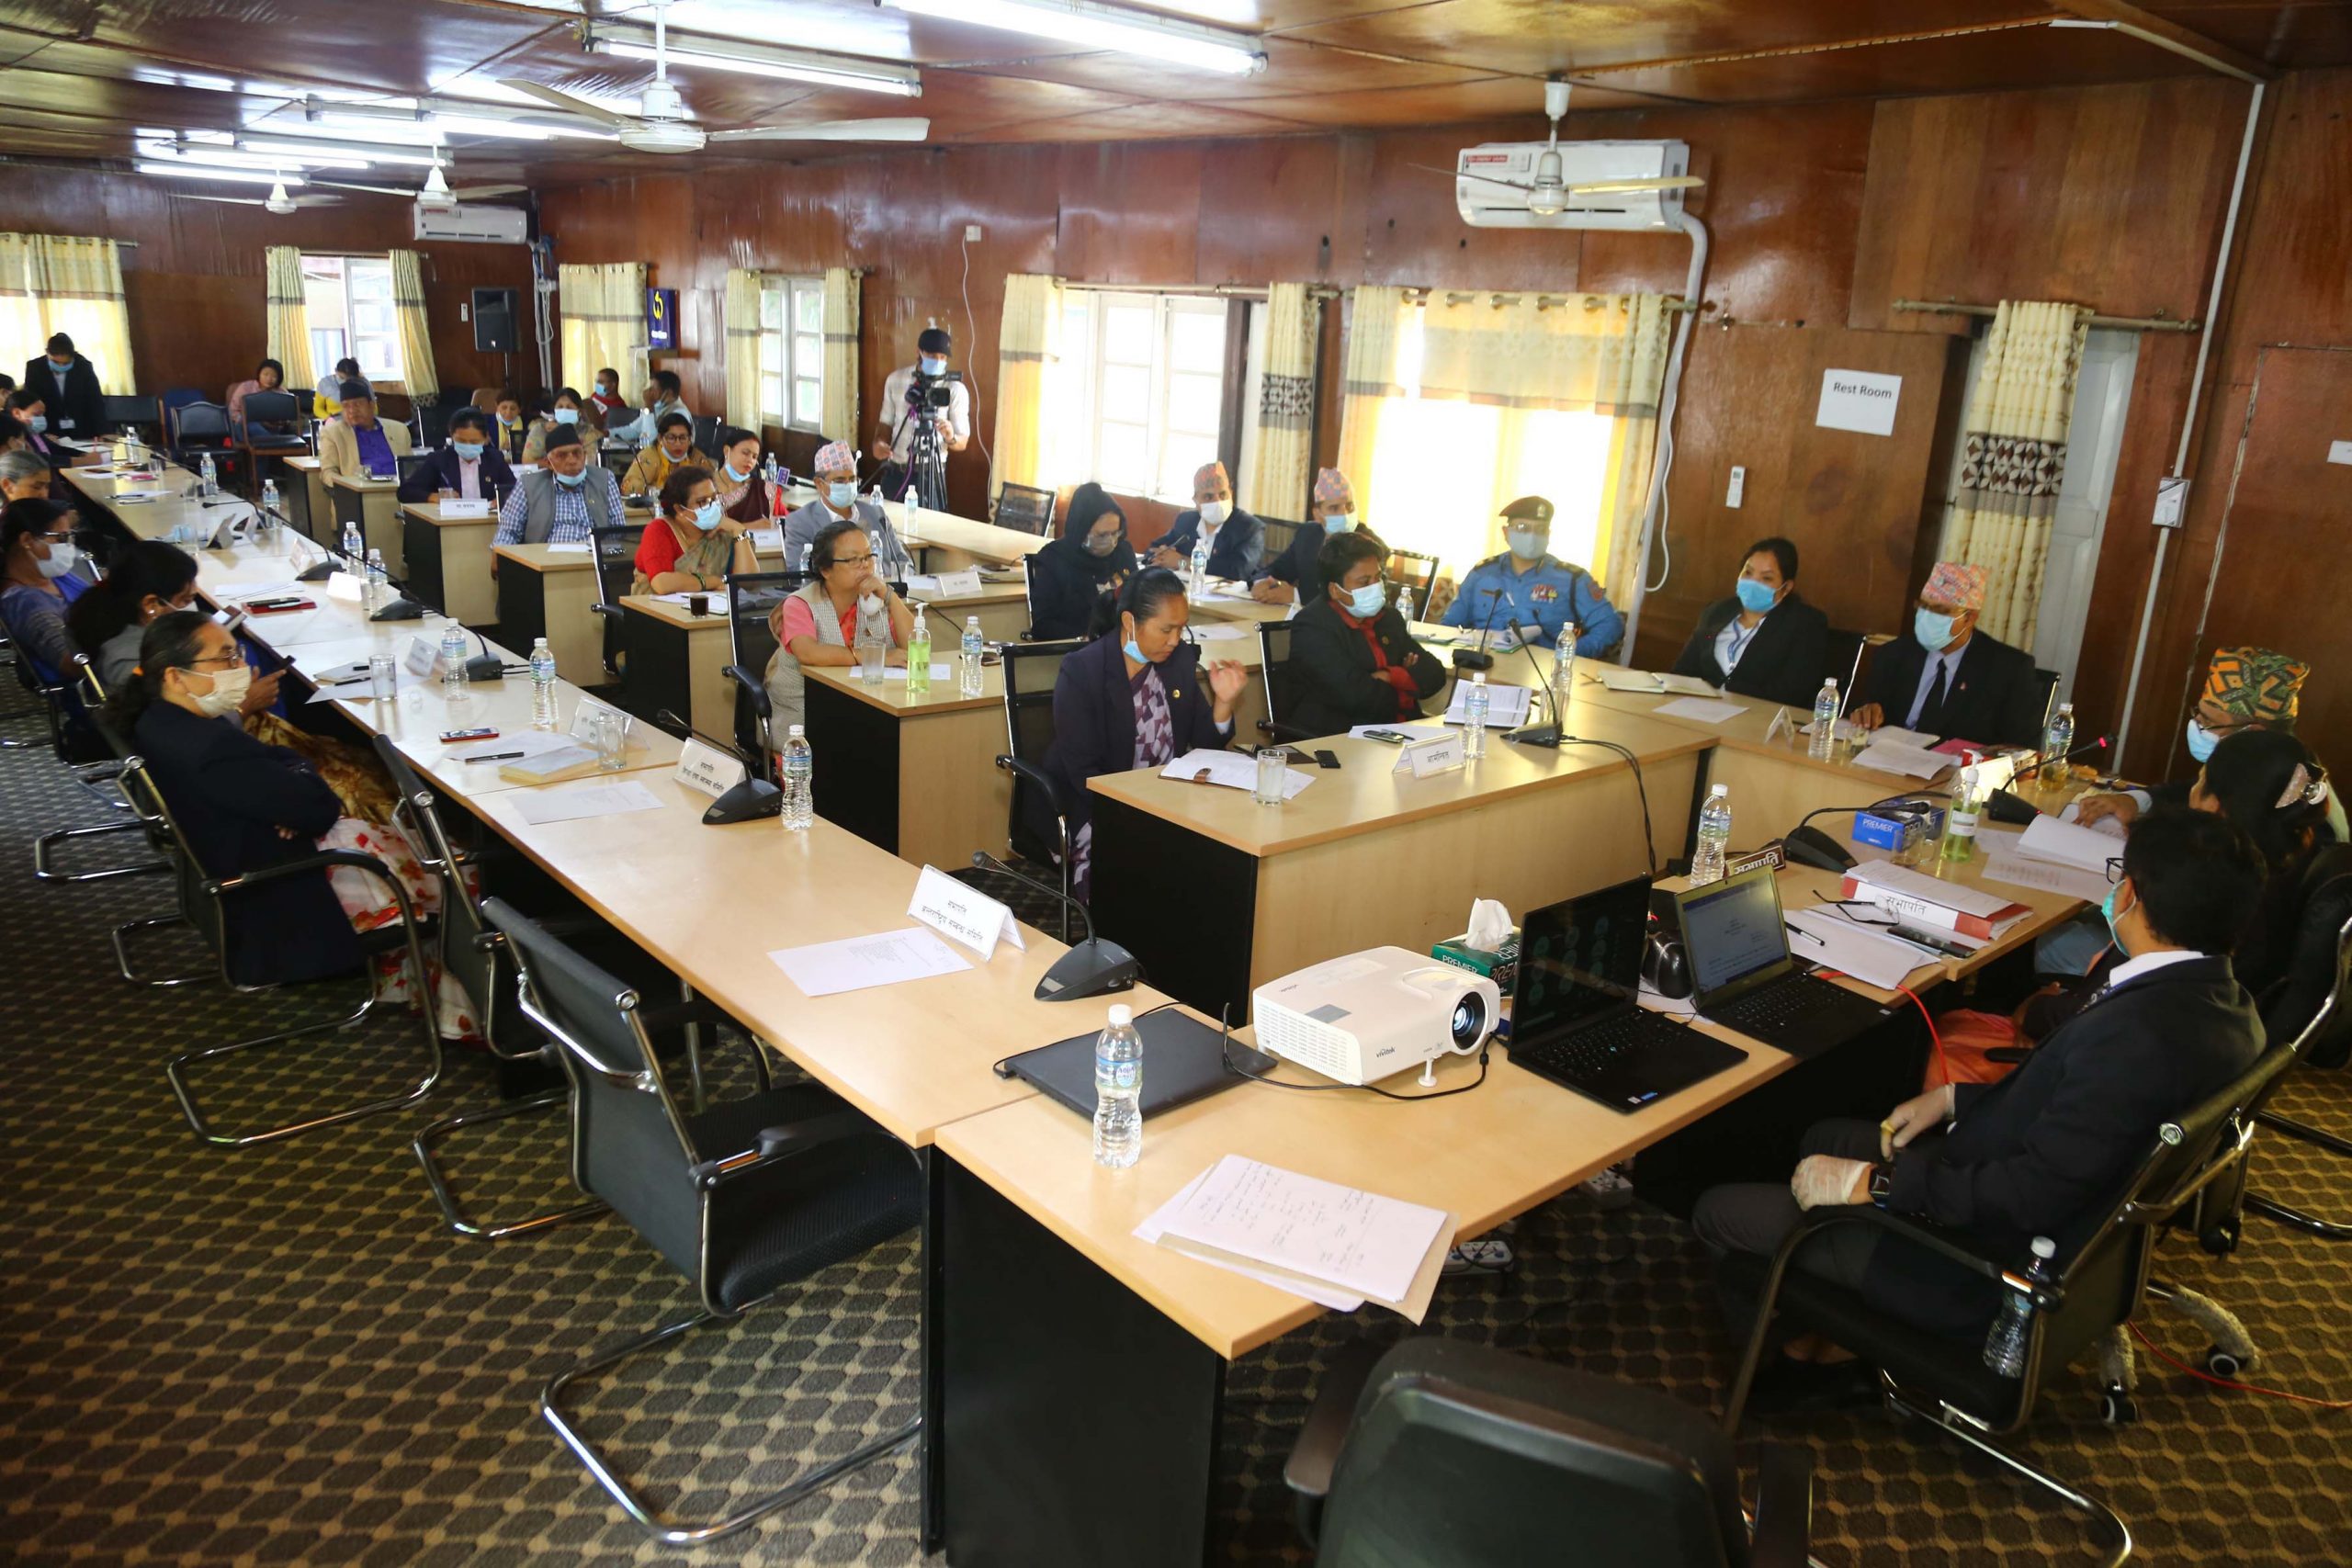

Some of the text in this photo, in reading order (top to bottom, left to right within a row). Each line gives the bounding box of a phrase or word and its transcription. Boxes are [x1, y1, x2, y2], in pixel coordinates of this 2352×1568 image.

[1833, 381, 1893, 400] Rest Room
[1862, 818, 1894, 833] PREMIER
[1886, 896, 1928, 916] सभापति
[1442, 954, 1478, 974] PREMIER
